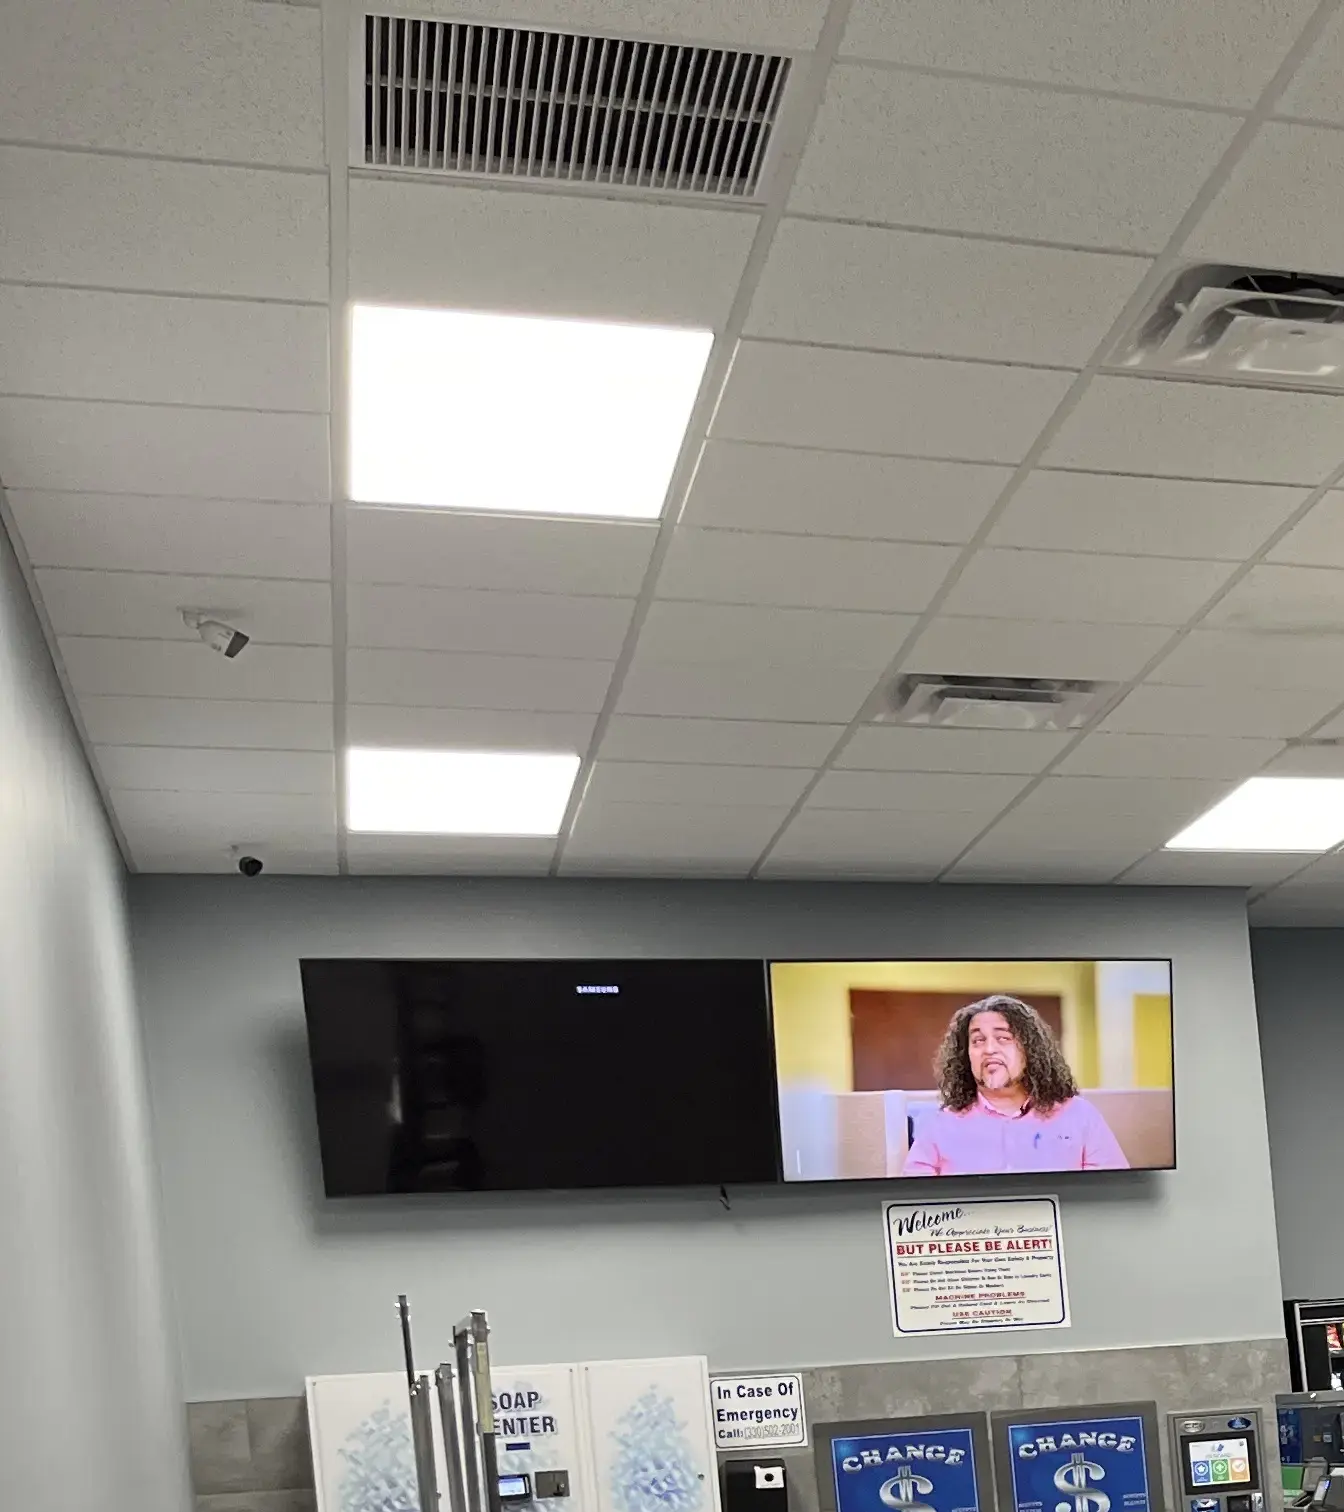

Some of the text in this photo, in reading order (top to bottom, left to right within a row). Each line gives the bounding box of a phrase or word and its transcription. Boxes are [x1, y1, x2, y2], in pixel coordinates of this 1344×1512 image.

[896, 1238, 1053, 1256] BUT PLEASE BE ALERT!
[935, 1291, 1026, 1302] MACHINE PROBLEMS
[972, 1309, 1012, 1317] CAUTION
[717, 1382, 794, 1400] In Case Of
[716, 1407, 799, 1424] Emergency
[493, 1416, 555, 1435] ENTER
[718, 1428, 744, 1439] Call:
[1018, 1431, 1137, 1459] CHANGE
[842, 1444, 966, 1473] CHANGE
